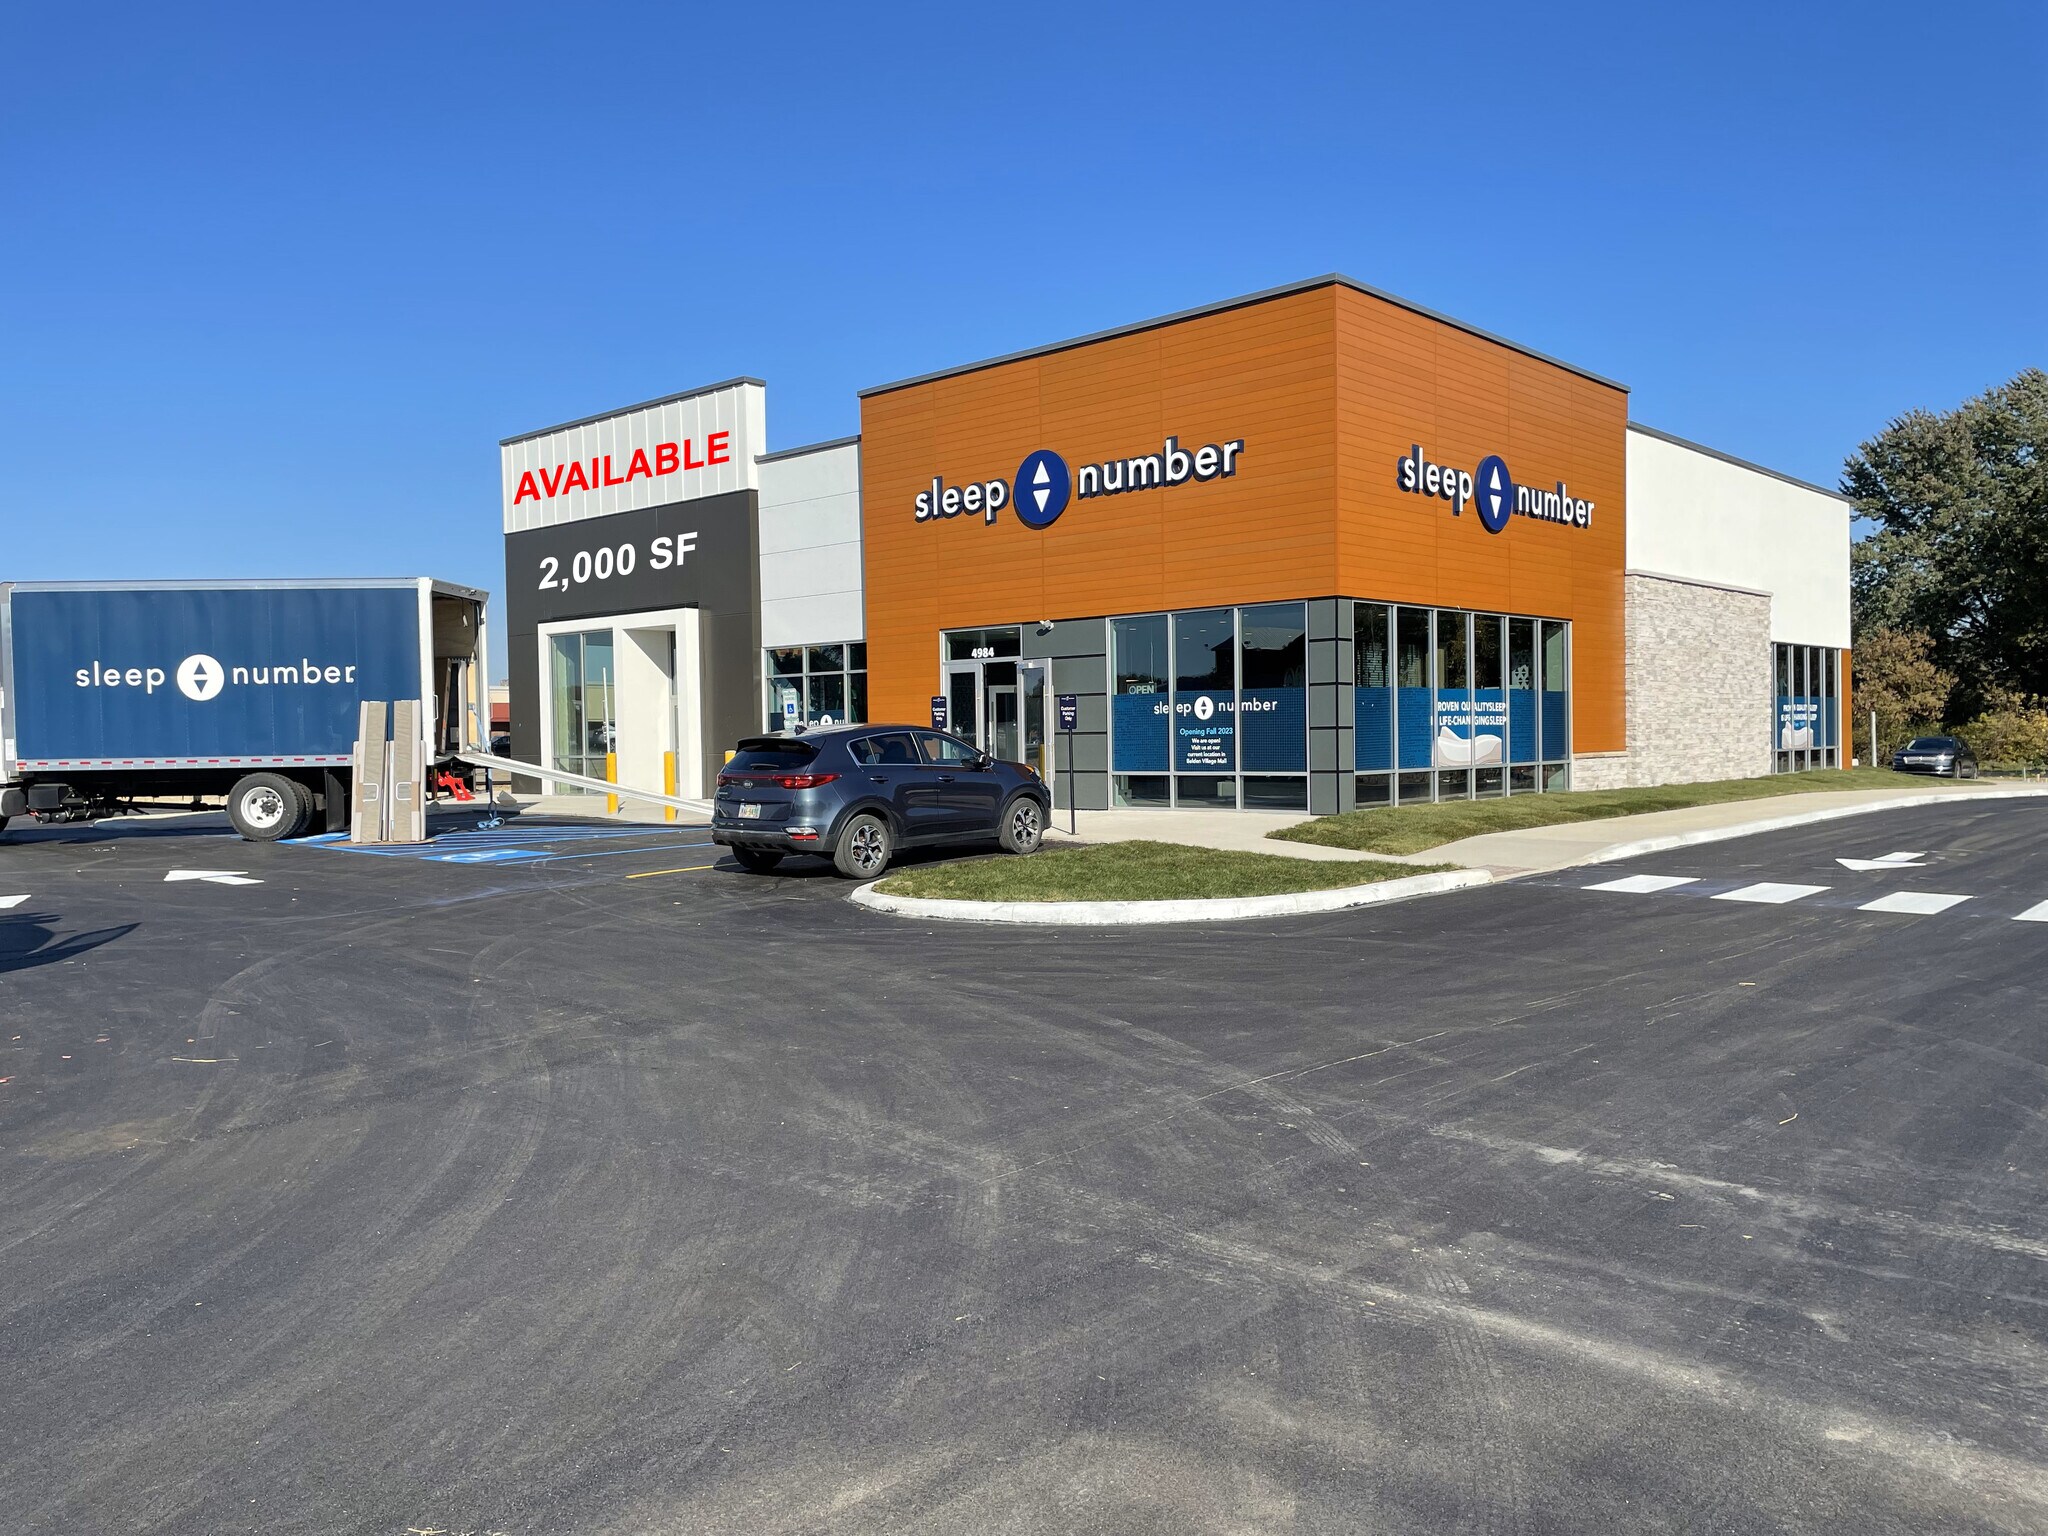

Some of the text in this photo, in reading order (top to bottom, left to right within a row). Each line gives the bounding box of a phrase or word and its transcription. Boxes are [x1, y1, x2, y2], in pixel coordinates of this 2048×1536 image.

[513, 430, 730, 505] AVAILABLE
[914, 436, 1242, 524] sleep number
[1398, 445, 1594, 528] sleep number
[538, 531, 698, 592] 2,000 SF
[971, 647, 994, 658] 4984
[75, 658, 355, 694] sleep number
[1128, 685, 1155, 694] OPEN
[1153, 697, 1278, 717] sleep number
[1437, 701, 1459, 712] ROVEN
[1179, 727, 1233, 737] Opening Fall 2023
